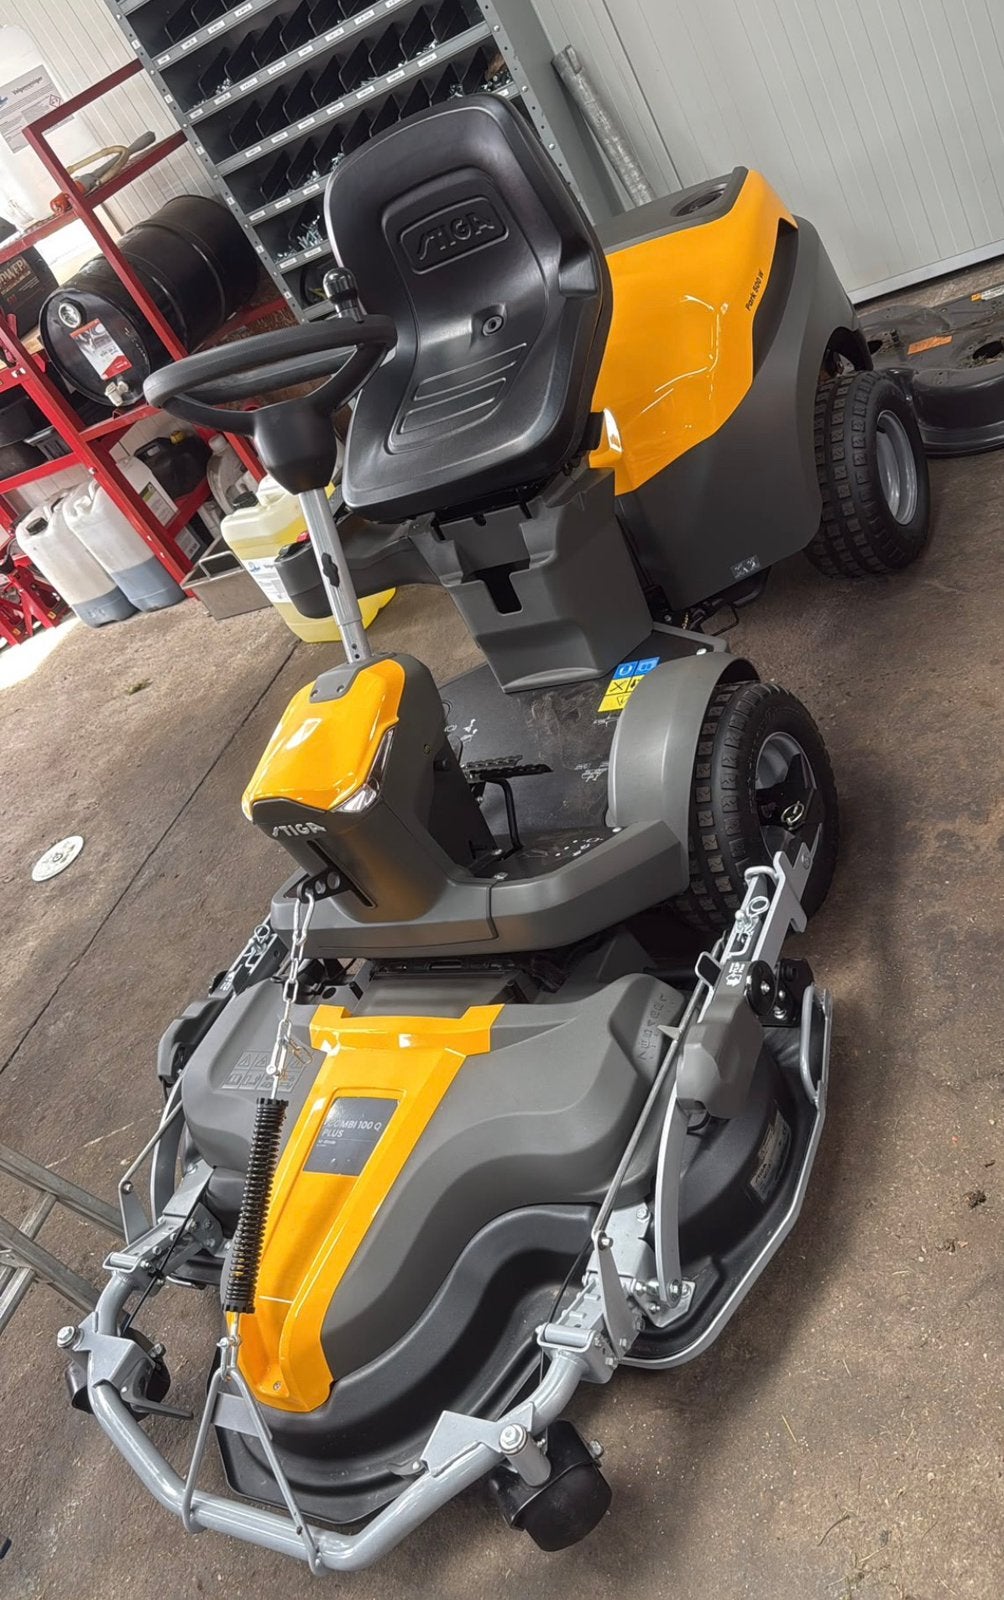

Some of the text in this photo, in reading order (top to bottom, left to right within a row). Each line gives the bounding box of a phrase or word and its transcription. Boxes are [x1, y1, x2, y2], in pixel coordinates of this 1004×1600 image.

[417, 212, 495, 260] STIGA
[745, 292, 757, 311] Park
[752, 277, 762, 293] 500
[272, 822, 327, 838] STIGA
[321, 1128, 344, 1138] PLUS
[358, 1120, 374, 1130] 100
[373, 1122, 382, 1132] Q
